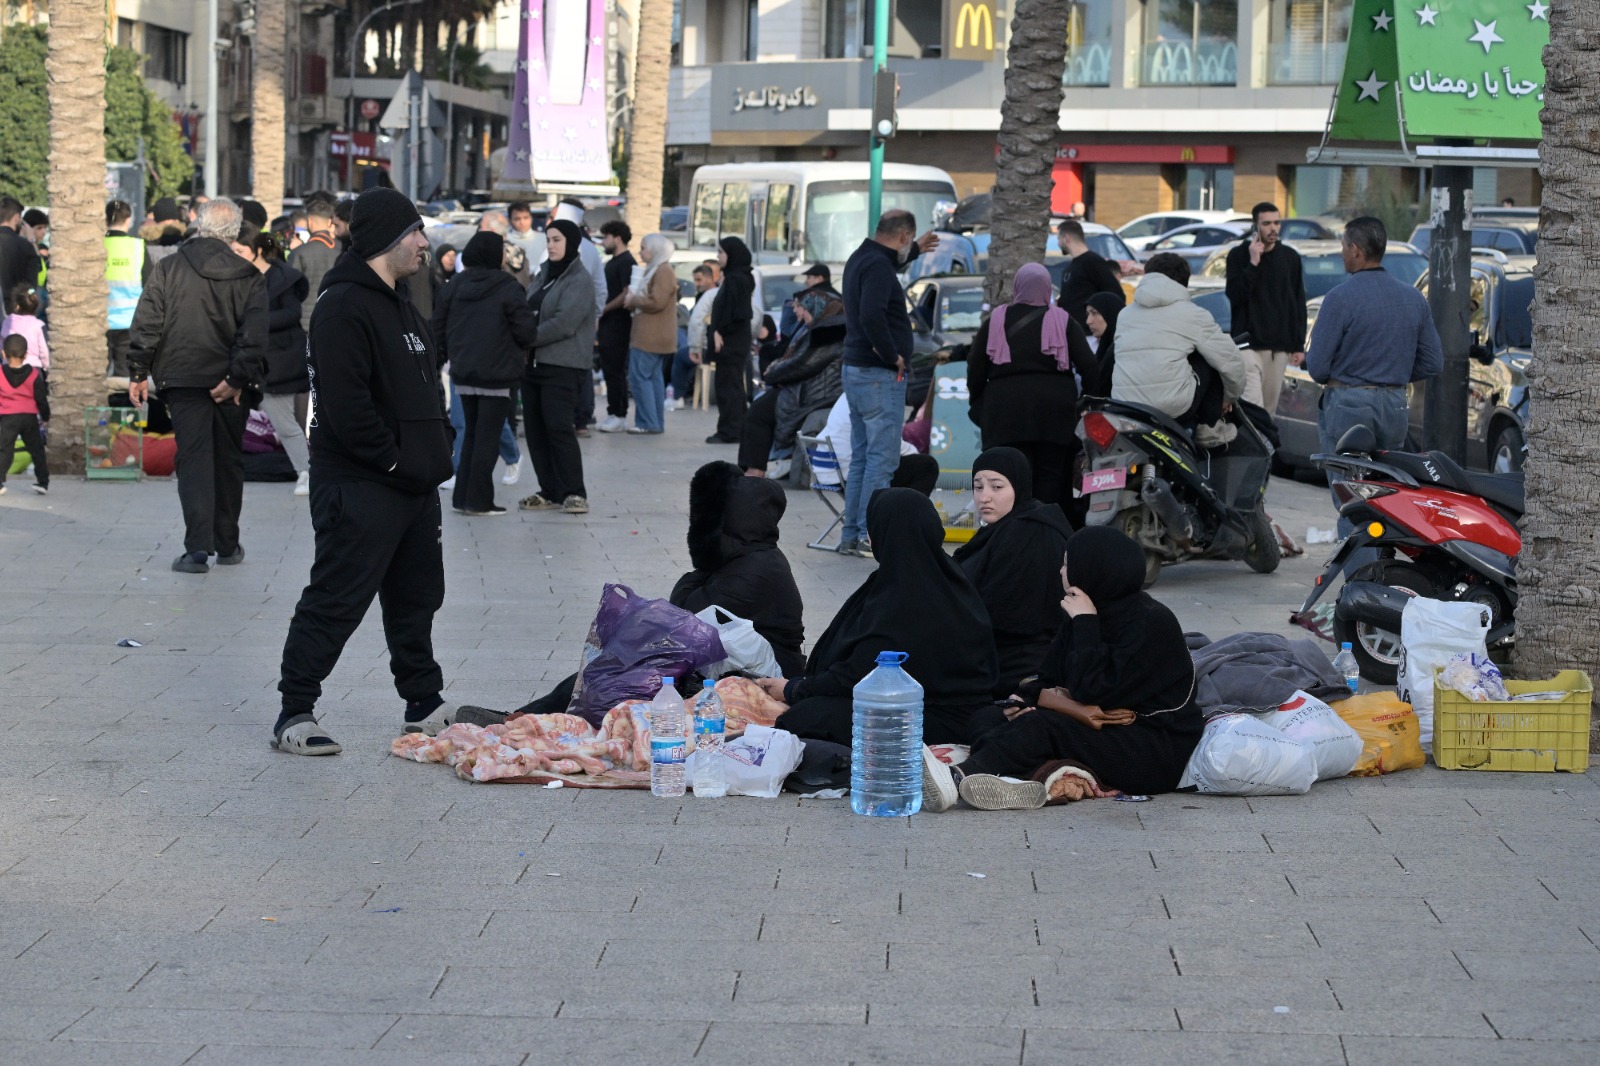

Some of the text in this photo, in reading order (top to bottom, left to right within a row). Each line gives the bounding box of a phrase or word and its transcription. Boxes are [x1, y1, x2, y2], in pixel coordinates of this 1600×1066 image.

[1408, 69, 1478, 99] رمضان
[1484, 71, 1499, 98] يا
[1055, 148, 1078, 159] ice
[1091, 473, 1116, 488] SYM
